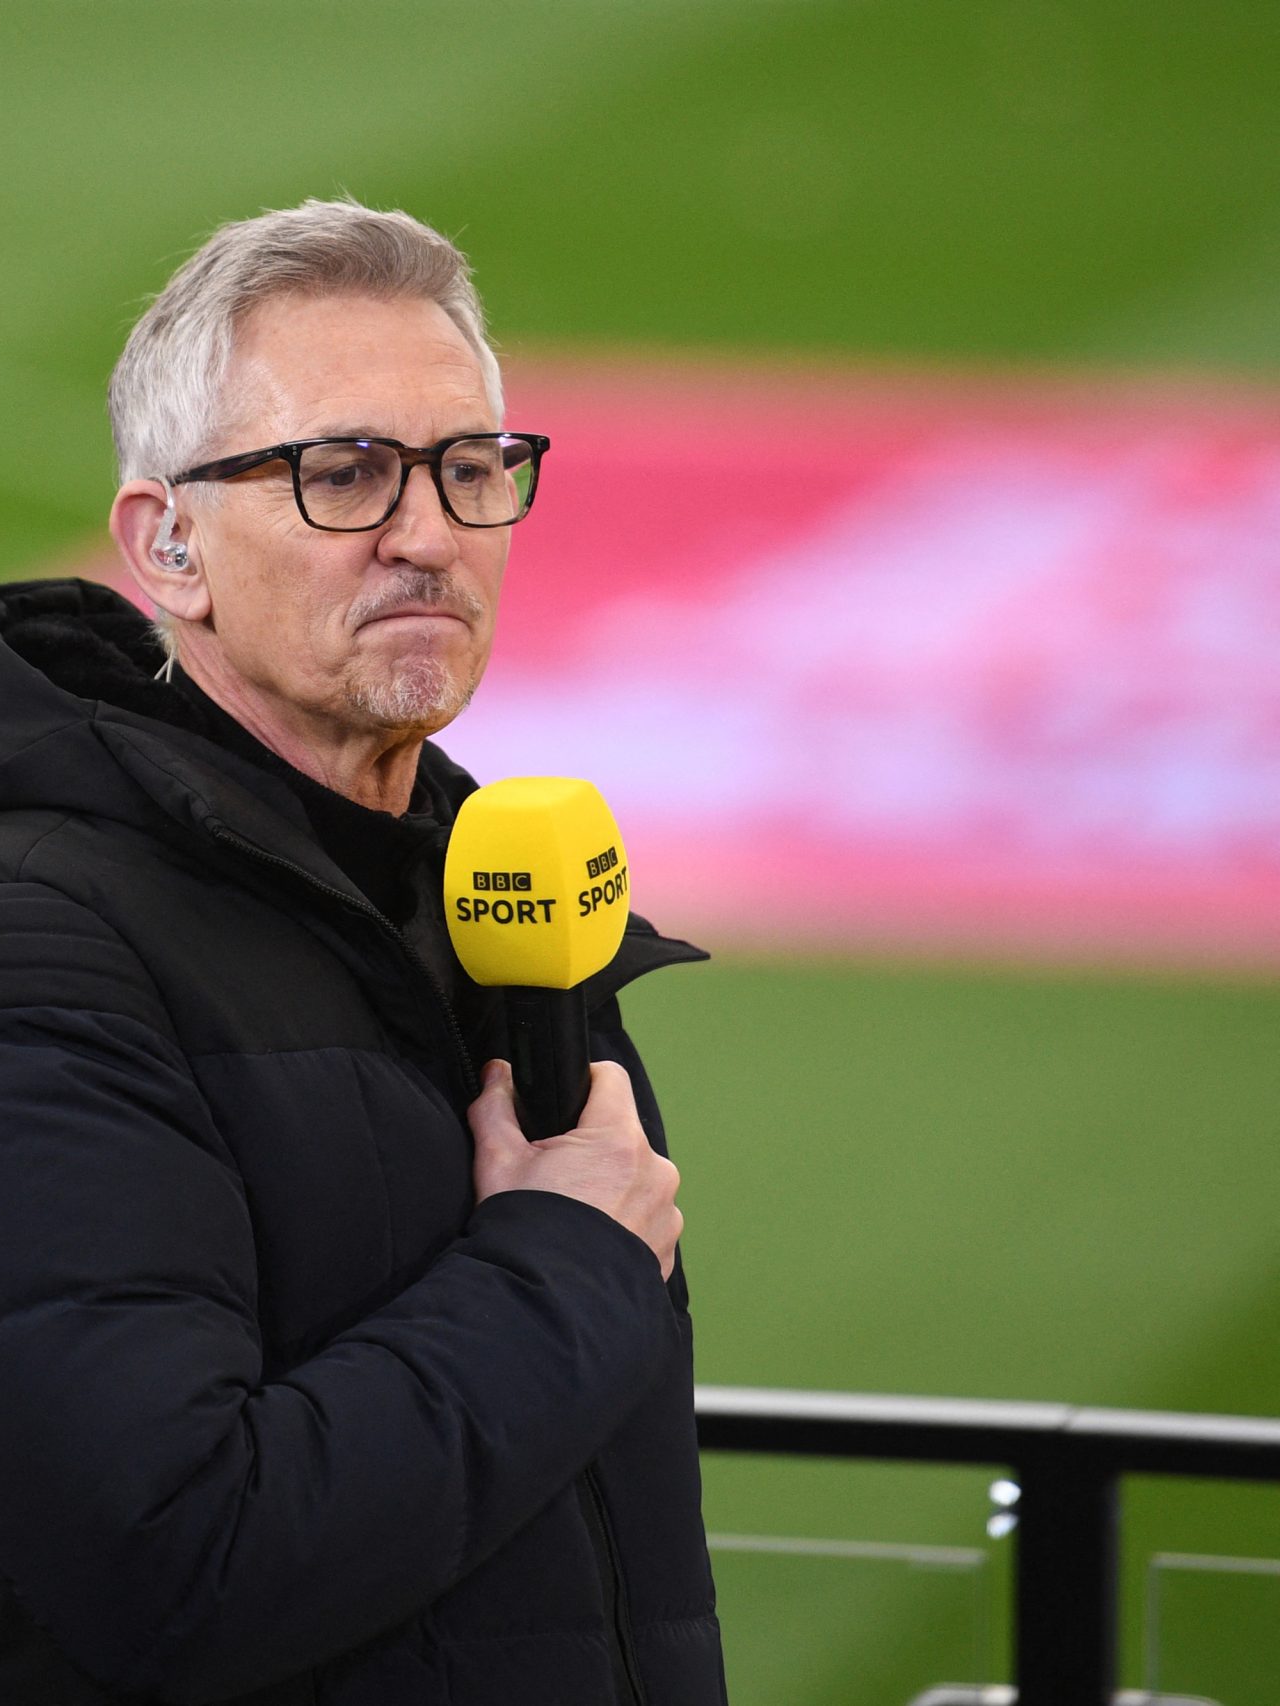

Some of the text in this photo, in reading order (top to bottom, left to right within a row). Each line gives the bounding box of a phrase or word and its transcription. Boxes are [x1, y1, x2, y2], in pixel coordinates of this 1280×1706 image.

[585, 846, 618, 879] BBC
[473, 871, 532, 891] BBC
[578, 866, 628, 917] SPORT
[456, 897, 556, 924] SPORT
